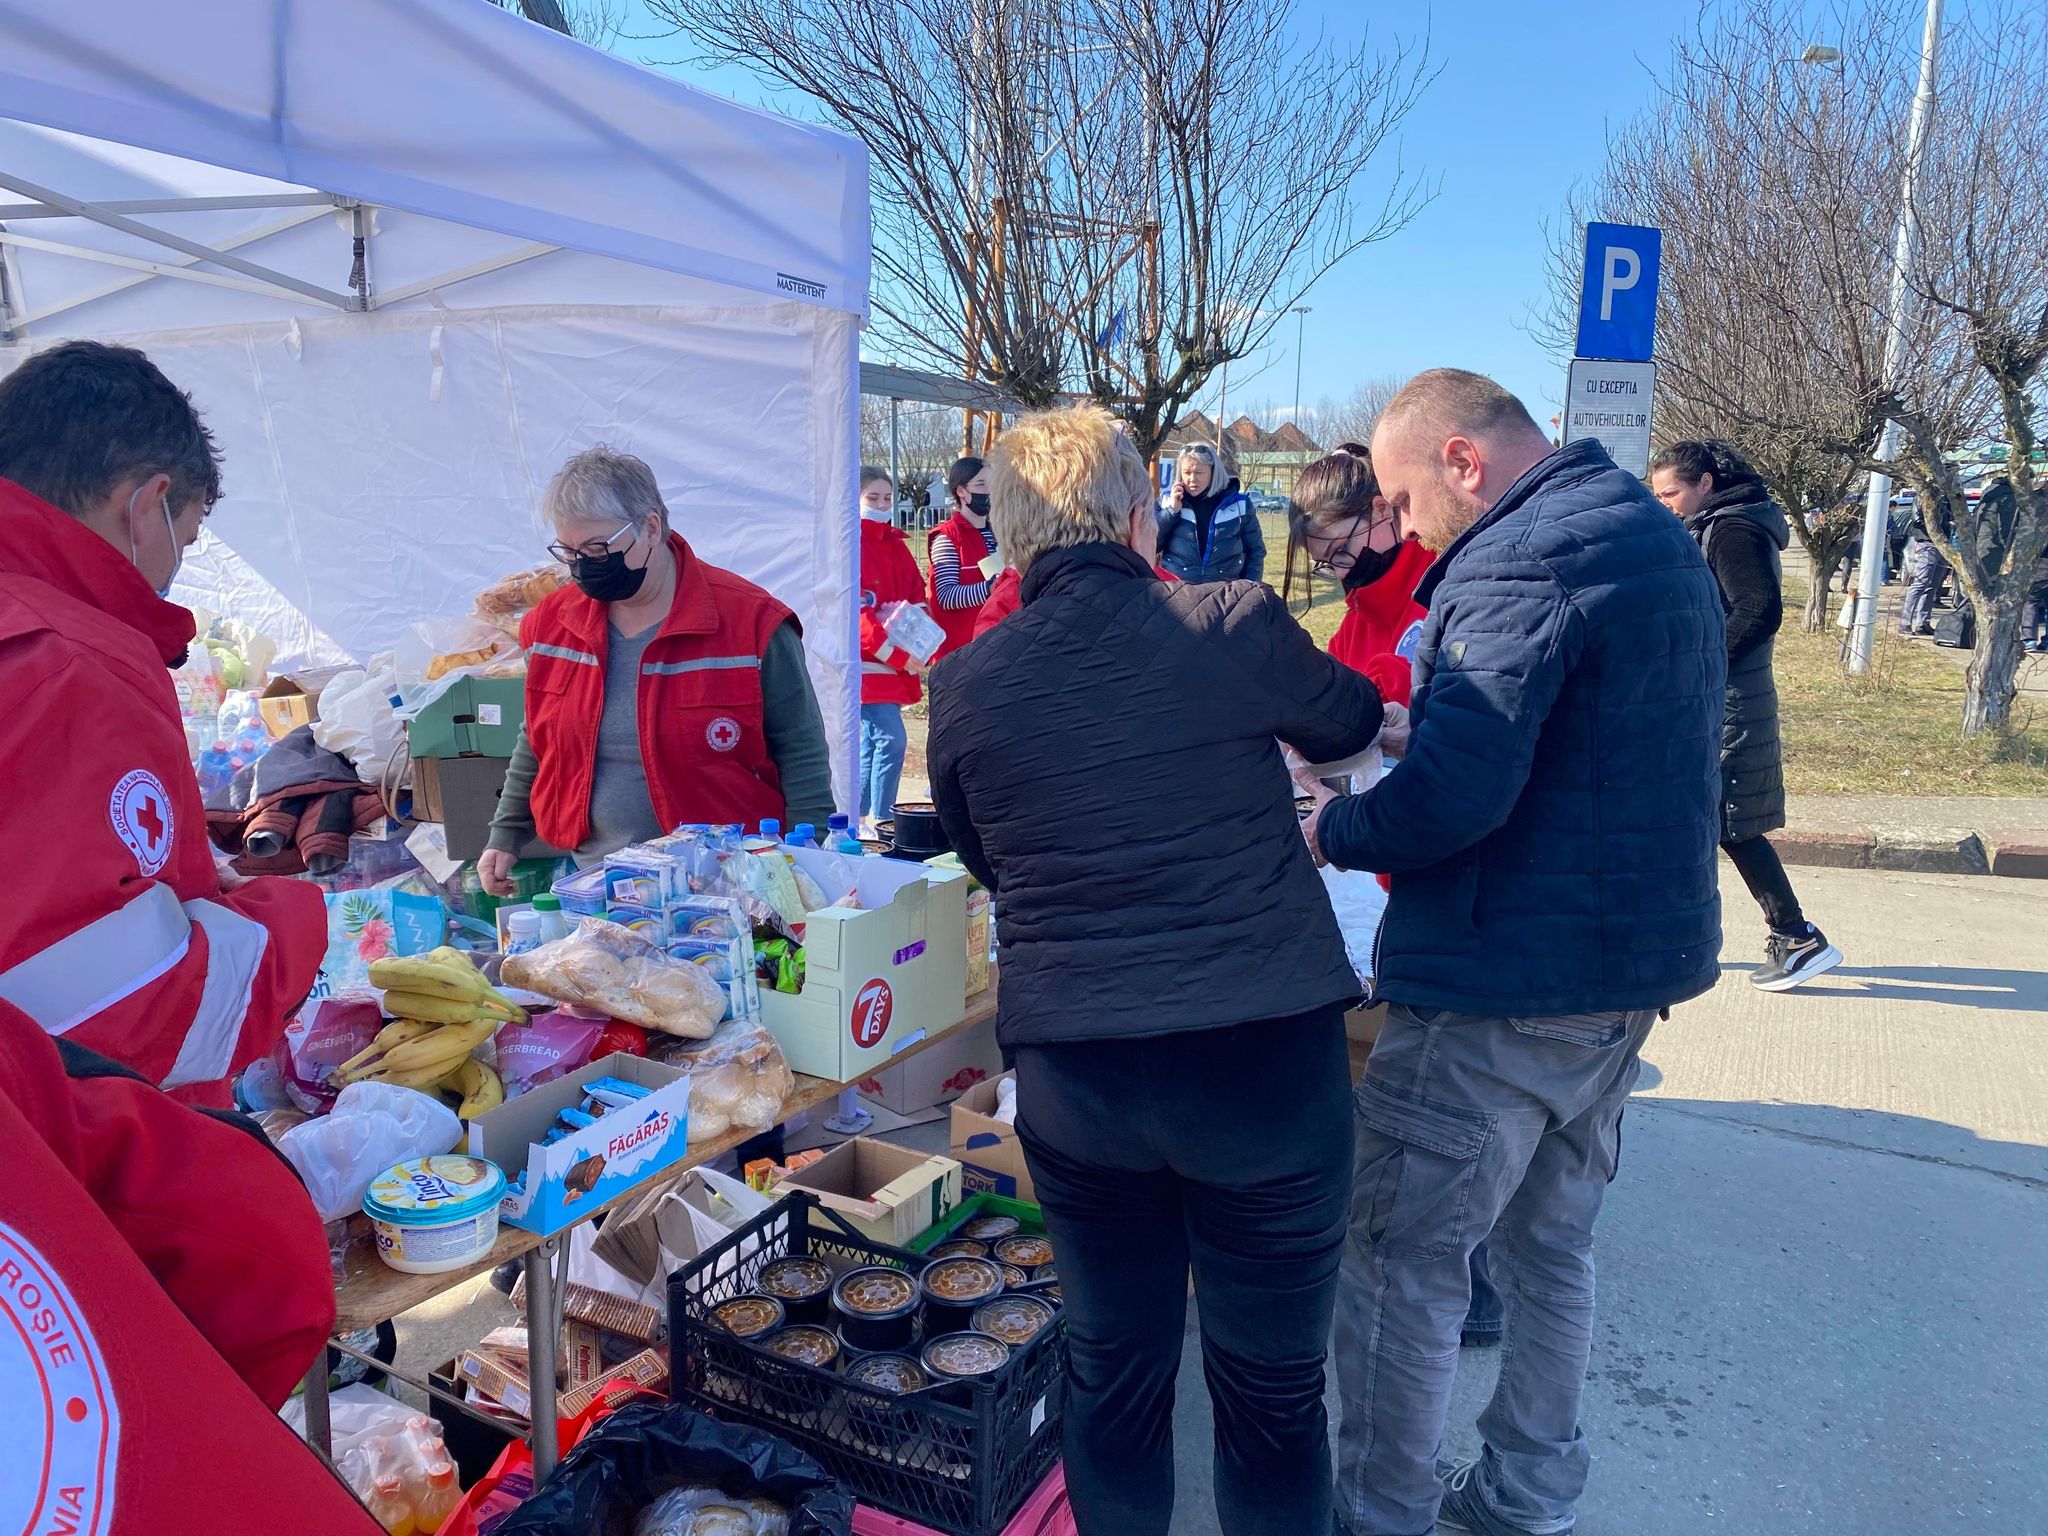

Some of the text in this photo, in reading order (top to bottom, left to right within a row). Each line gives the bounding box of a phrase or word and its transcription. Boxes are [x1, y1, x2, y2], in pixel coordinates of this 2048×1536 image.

[777, 277, 826, 299] MASTERTENT
[1600, 246, 1641, 321] P
[1586, 380, 1638, 395] CU EXCEPTIA
[1573, 412, 1647, 428] AUTOVEHICULELOR
[113, 779, 130, 836] SOCIETATEA
[859, 985, 883, 1041] 7
[870, 987, 889, 1034] DAYS
[962, 1176, 994, 1194] TORK
